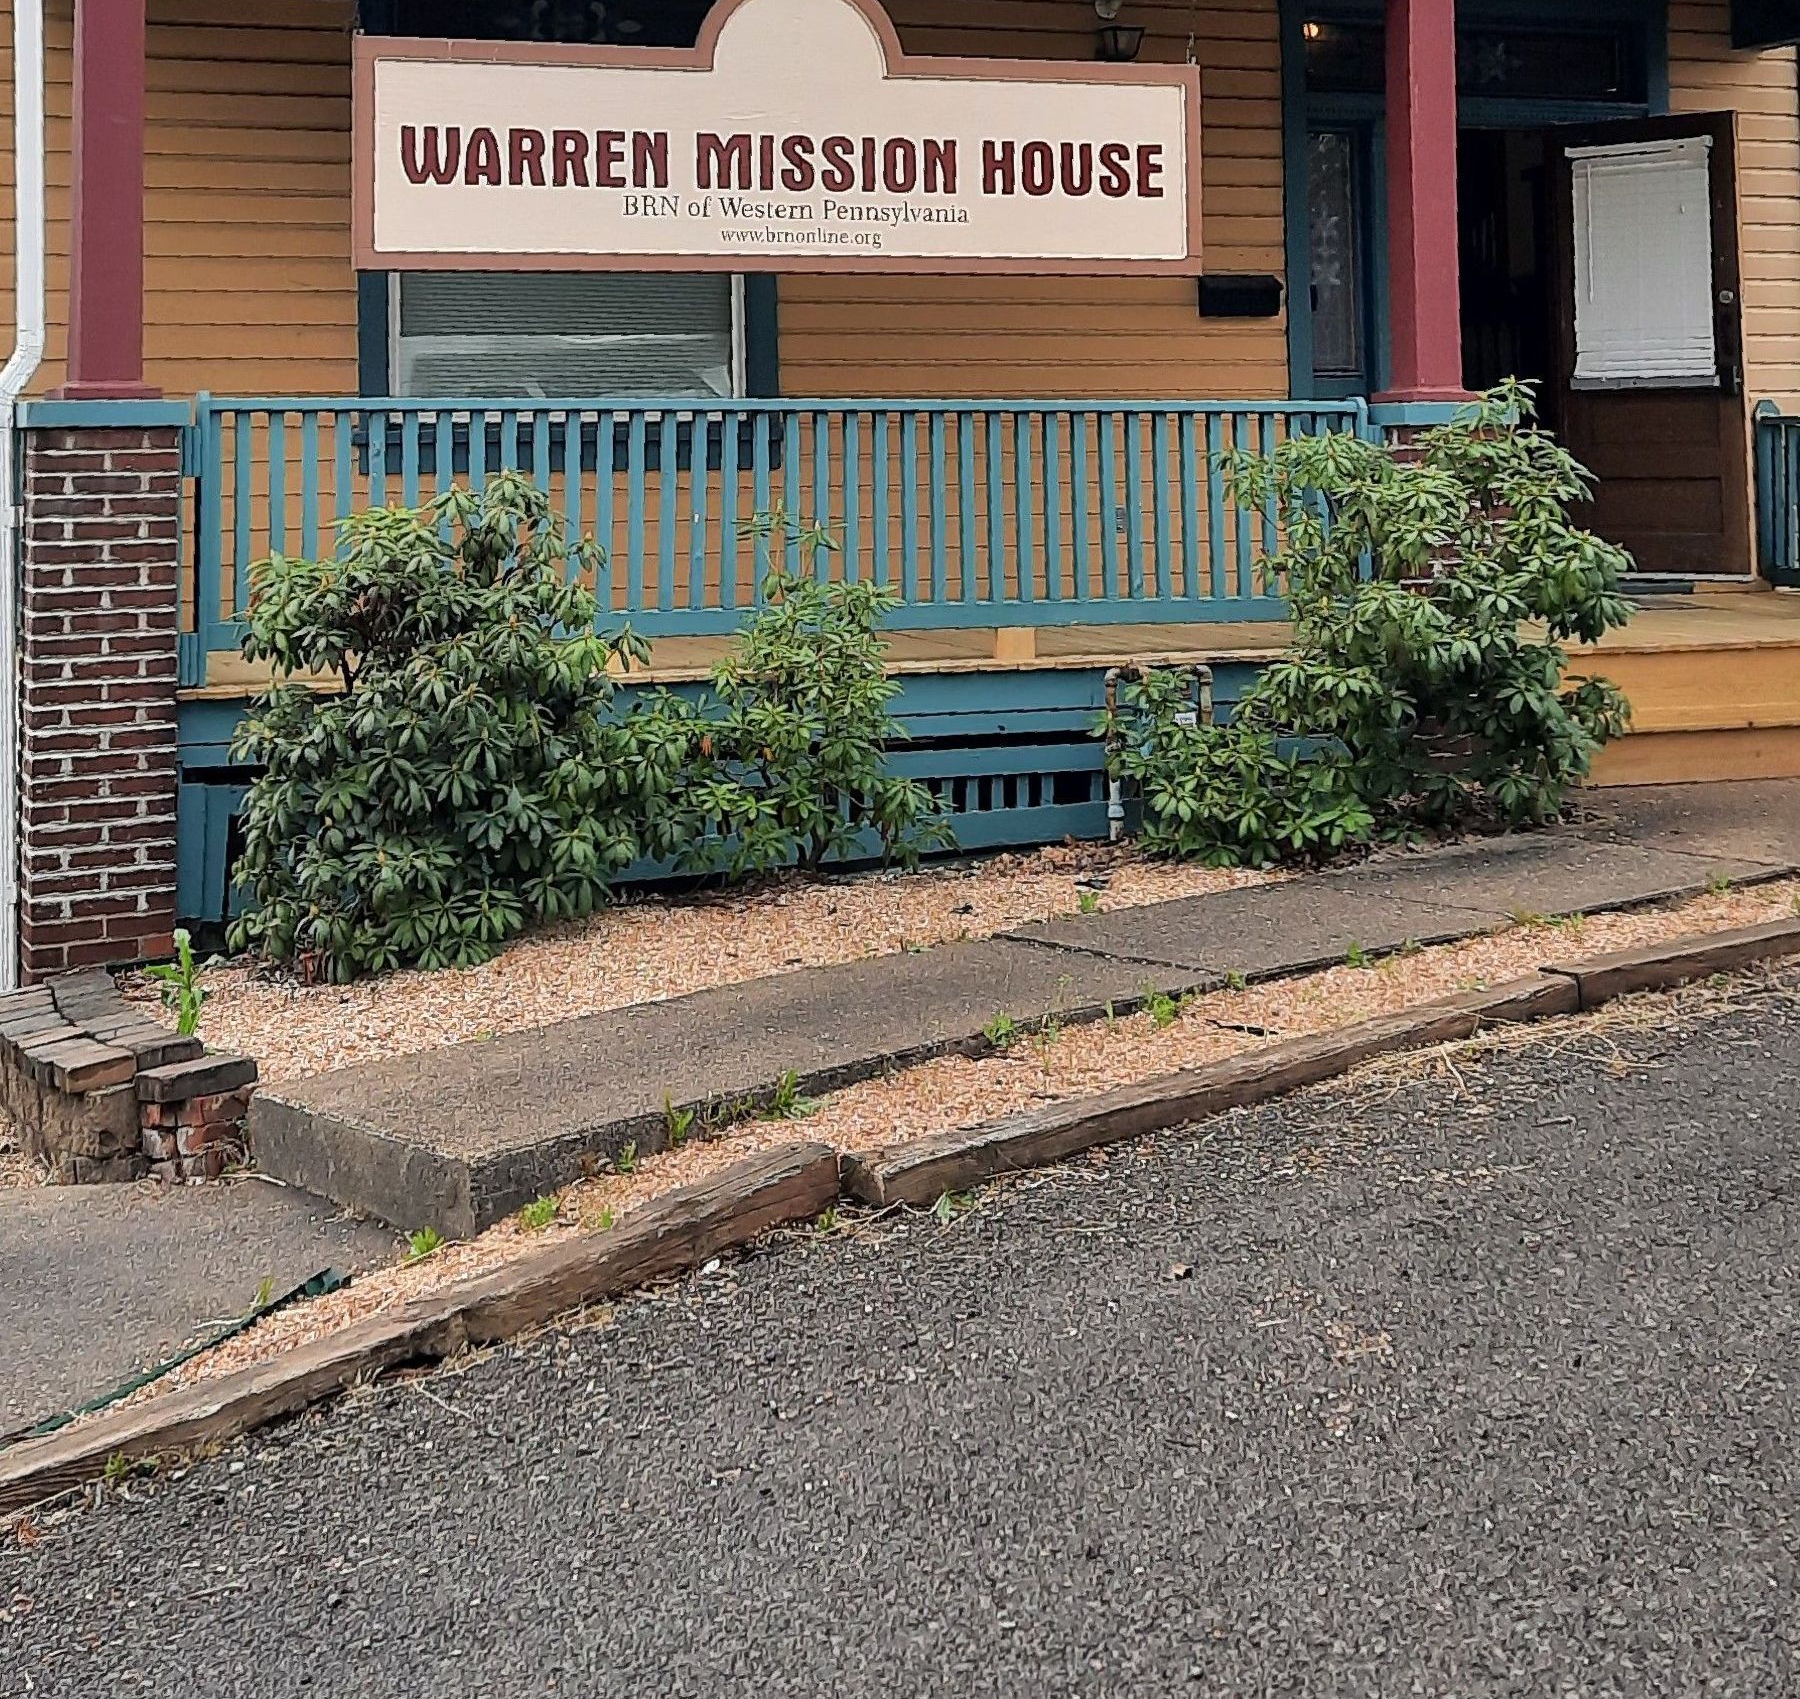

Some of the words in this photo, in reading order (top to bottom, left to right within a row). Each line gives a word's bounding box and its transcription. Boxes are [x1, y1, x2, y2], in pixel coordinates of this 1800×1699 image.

[401, 125, 669, 188] WARREN
[696, 132, 957, 194] MISSION
[982, 140, 1164, 198] HOUSE
[623, 195, 679, 217] BRN
[687, 196, 711, 218] of
[719, 197, 814, 220] Western
[822, 200, 969, 226] Pennsylvania
[721, 226, 882, 248] www.brnonline.org
